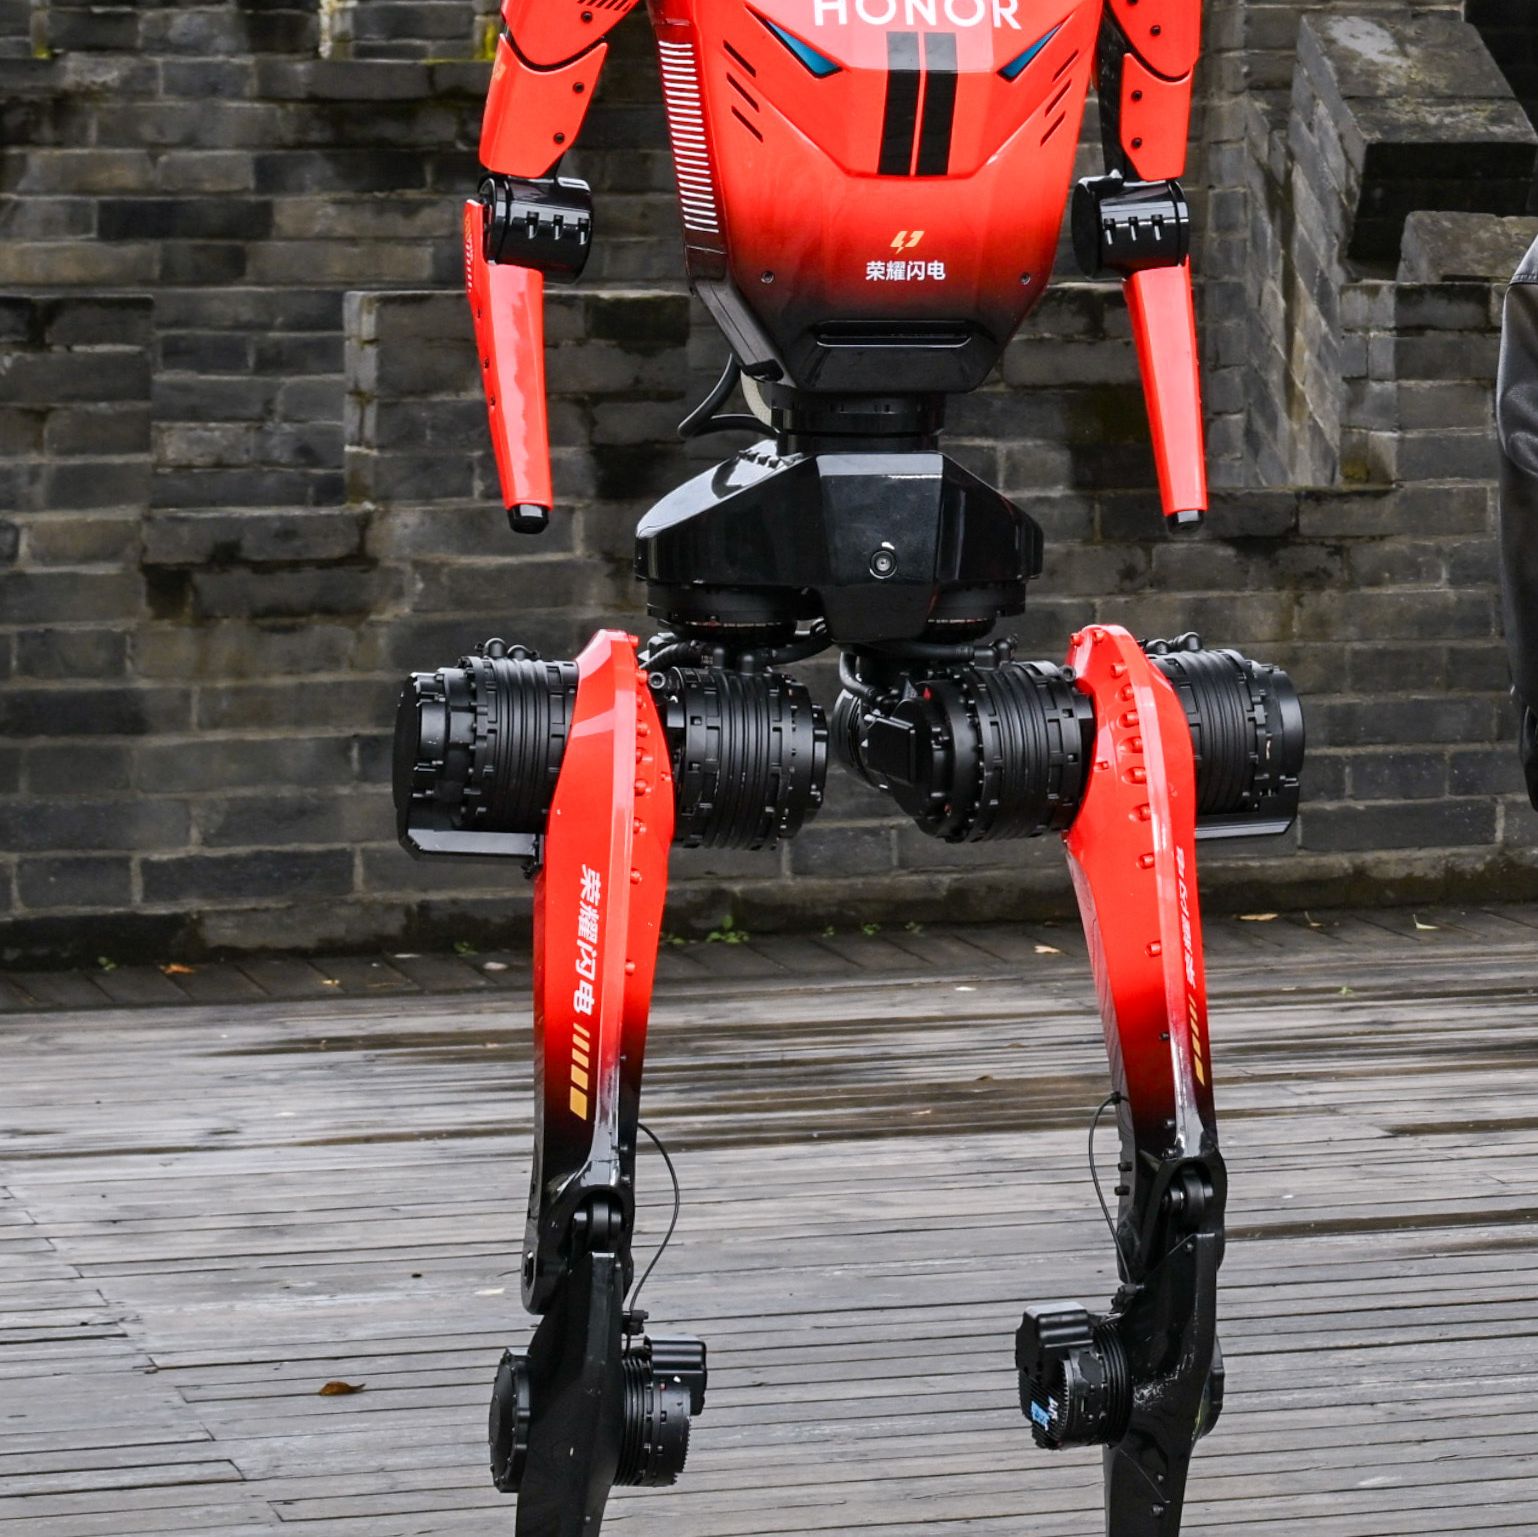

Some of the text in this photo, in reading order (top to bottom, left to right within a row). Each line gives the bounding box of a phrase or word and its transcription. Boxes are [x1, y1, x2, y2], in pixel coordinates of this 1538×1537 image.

[865, 260, 946, 281] 荣耀闪电
[573, 863, 602, 1016] 荣耀闪电
